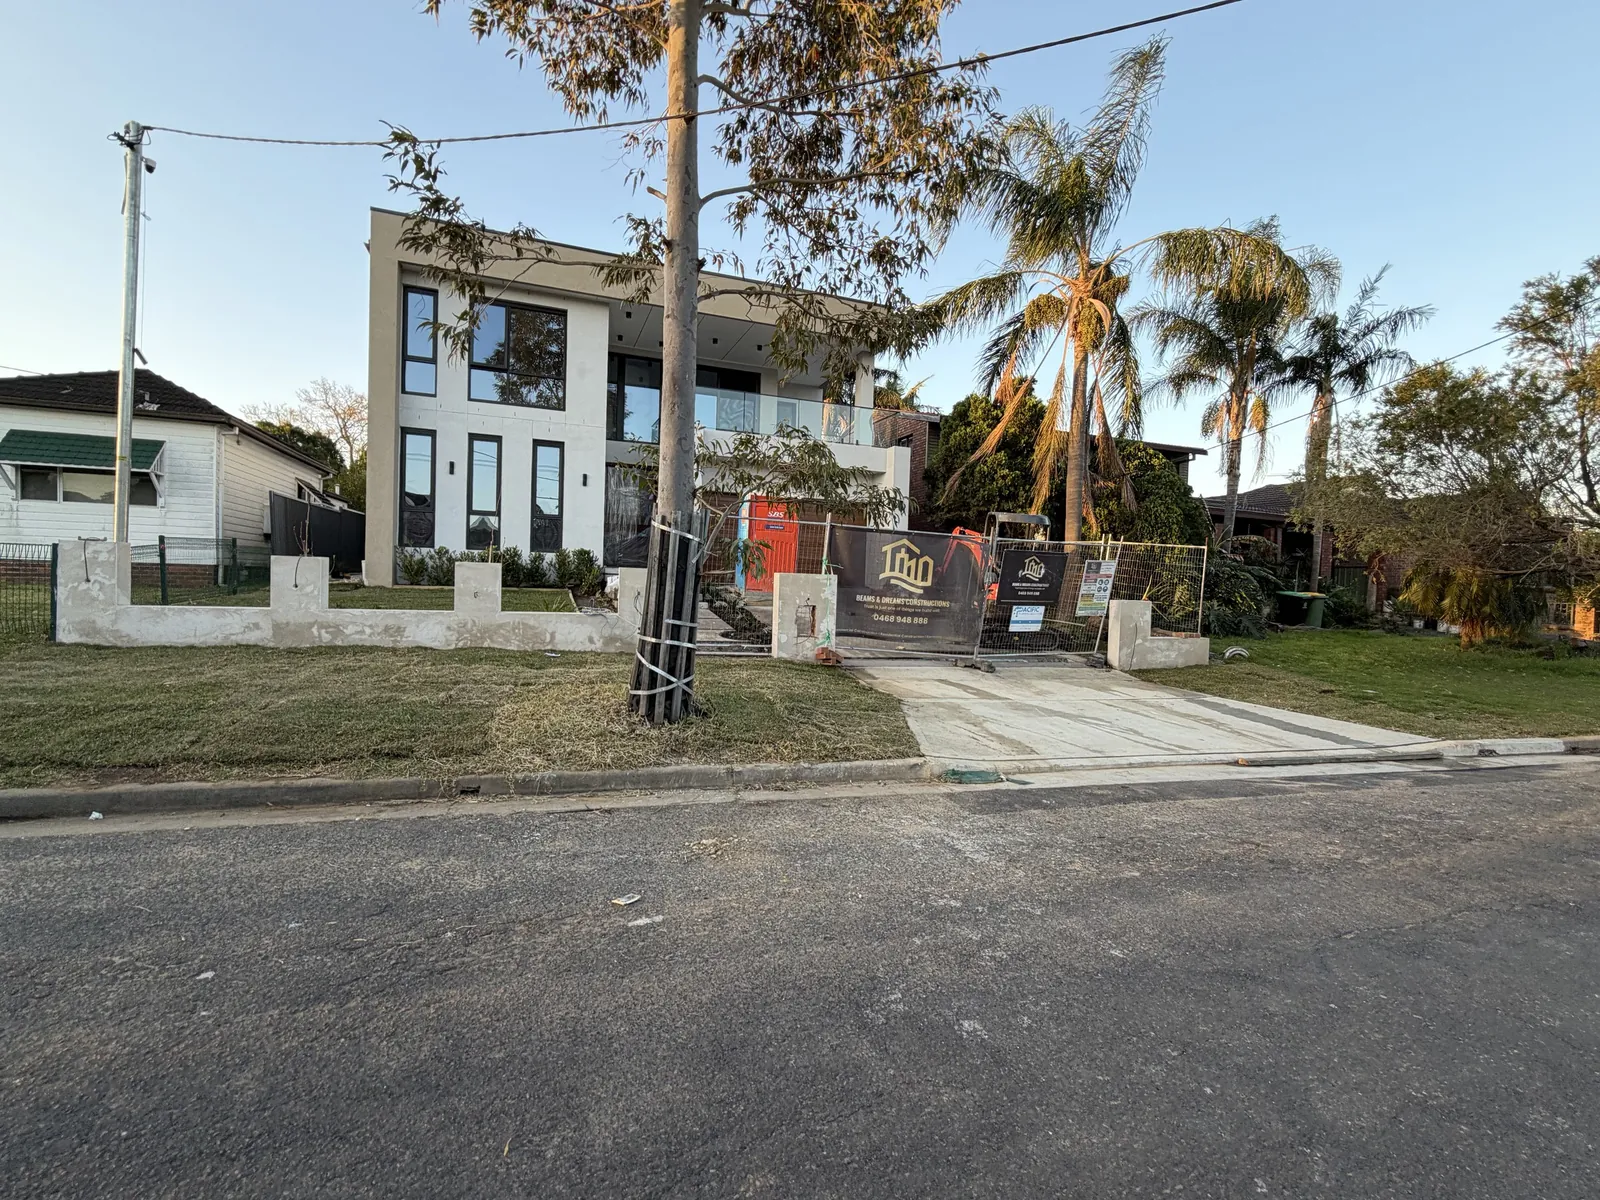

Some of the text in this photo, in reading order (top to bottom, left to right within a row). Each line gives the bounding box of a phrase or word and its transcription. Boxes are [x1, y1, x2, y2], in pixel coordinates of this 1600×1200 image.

[856, 594, 875, 602] BEAMS
[882, 596, 905, 605] DREAMS
[905, 598, 951, 608] CONSTRUCTIONS
[873, 614, 929, 625] 0468 948 888
